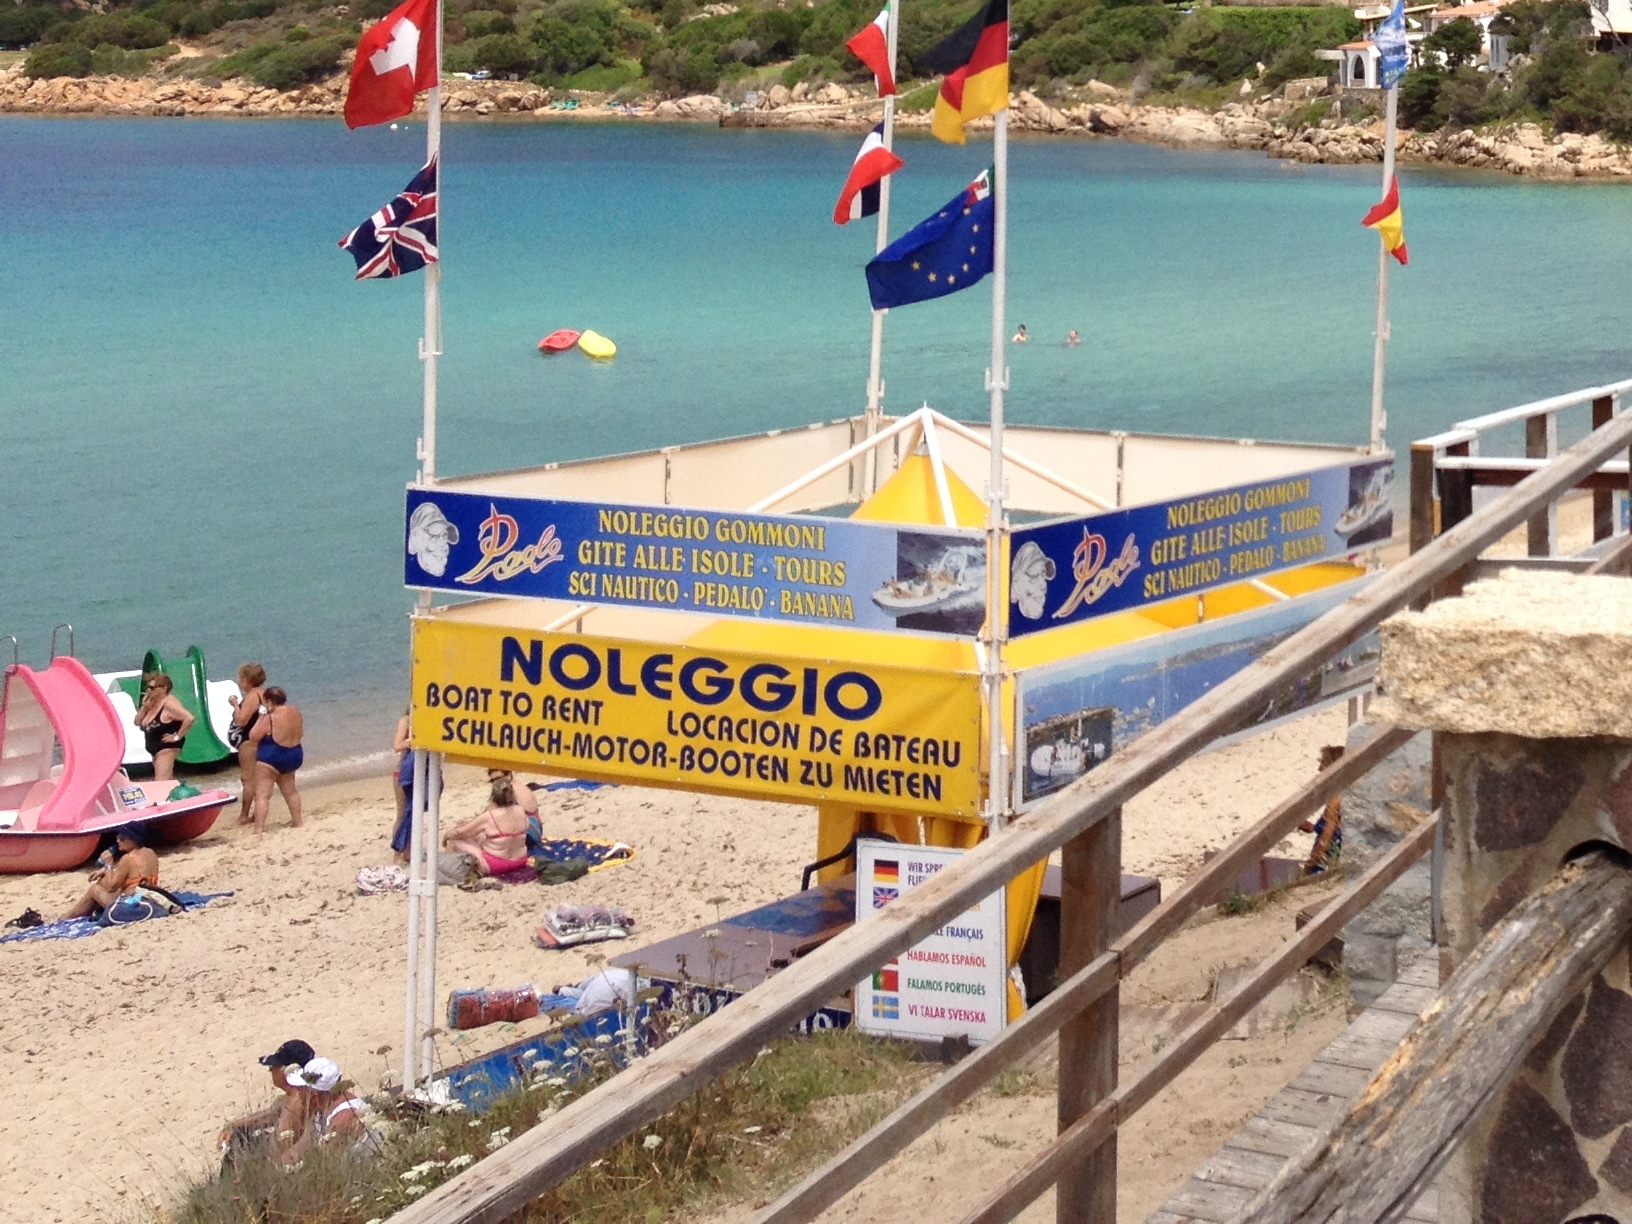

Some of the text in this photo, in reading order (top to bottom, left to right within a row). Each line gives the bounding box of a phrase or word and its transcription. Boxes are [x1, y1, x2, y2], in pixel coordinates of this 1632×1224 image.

[1167, 478, 1311, 530] NOLEGGIO GOMMONI
[454, 502, 564, 584] Paolo
[598, 509, 825, 551] NOLEGGIO GOMMONI
[1151, 505, 1322, 565] GITE ALLE ISOLE TOURS
[578, 539, 847, 587] GITE ALLE ISOLE TOURS
[1144, 570, 1165, 598] SCI
[1168, 558, 1221, 592] NAUTICO
[1283, 533, 1326, 562] BANANA
[568, 570, 597, 596] SCI
[601, 574, 679, 603] NAUTICO
[780, 589, 855, 621] BANANA
[500, 636, 882, 721] NOLEGGIO
[426, 682, 604, 726] BOAT TO RENT
[441, 717, 942, 802] SCHLAUCH-MOTOR-BOOTEN ZU MIETEN
[667, 710, 961, 768] LOCACION DE BATEAU
[907, 862, 924, 873] WIR
[907, 949, 986, 968] HABLAMOS ESPAÑOL
[946, 926, 983, 942] FRANÇAIS
[907, 978, 986, 996] FALAMOS PORTUGÉS
[908, 1004, 987, 1023] VI TALAR SVENSKA
